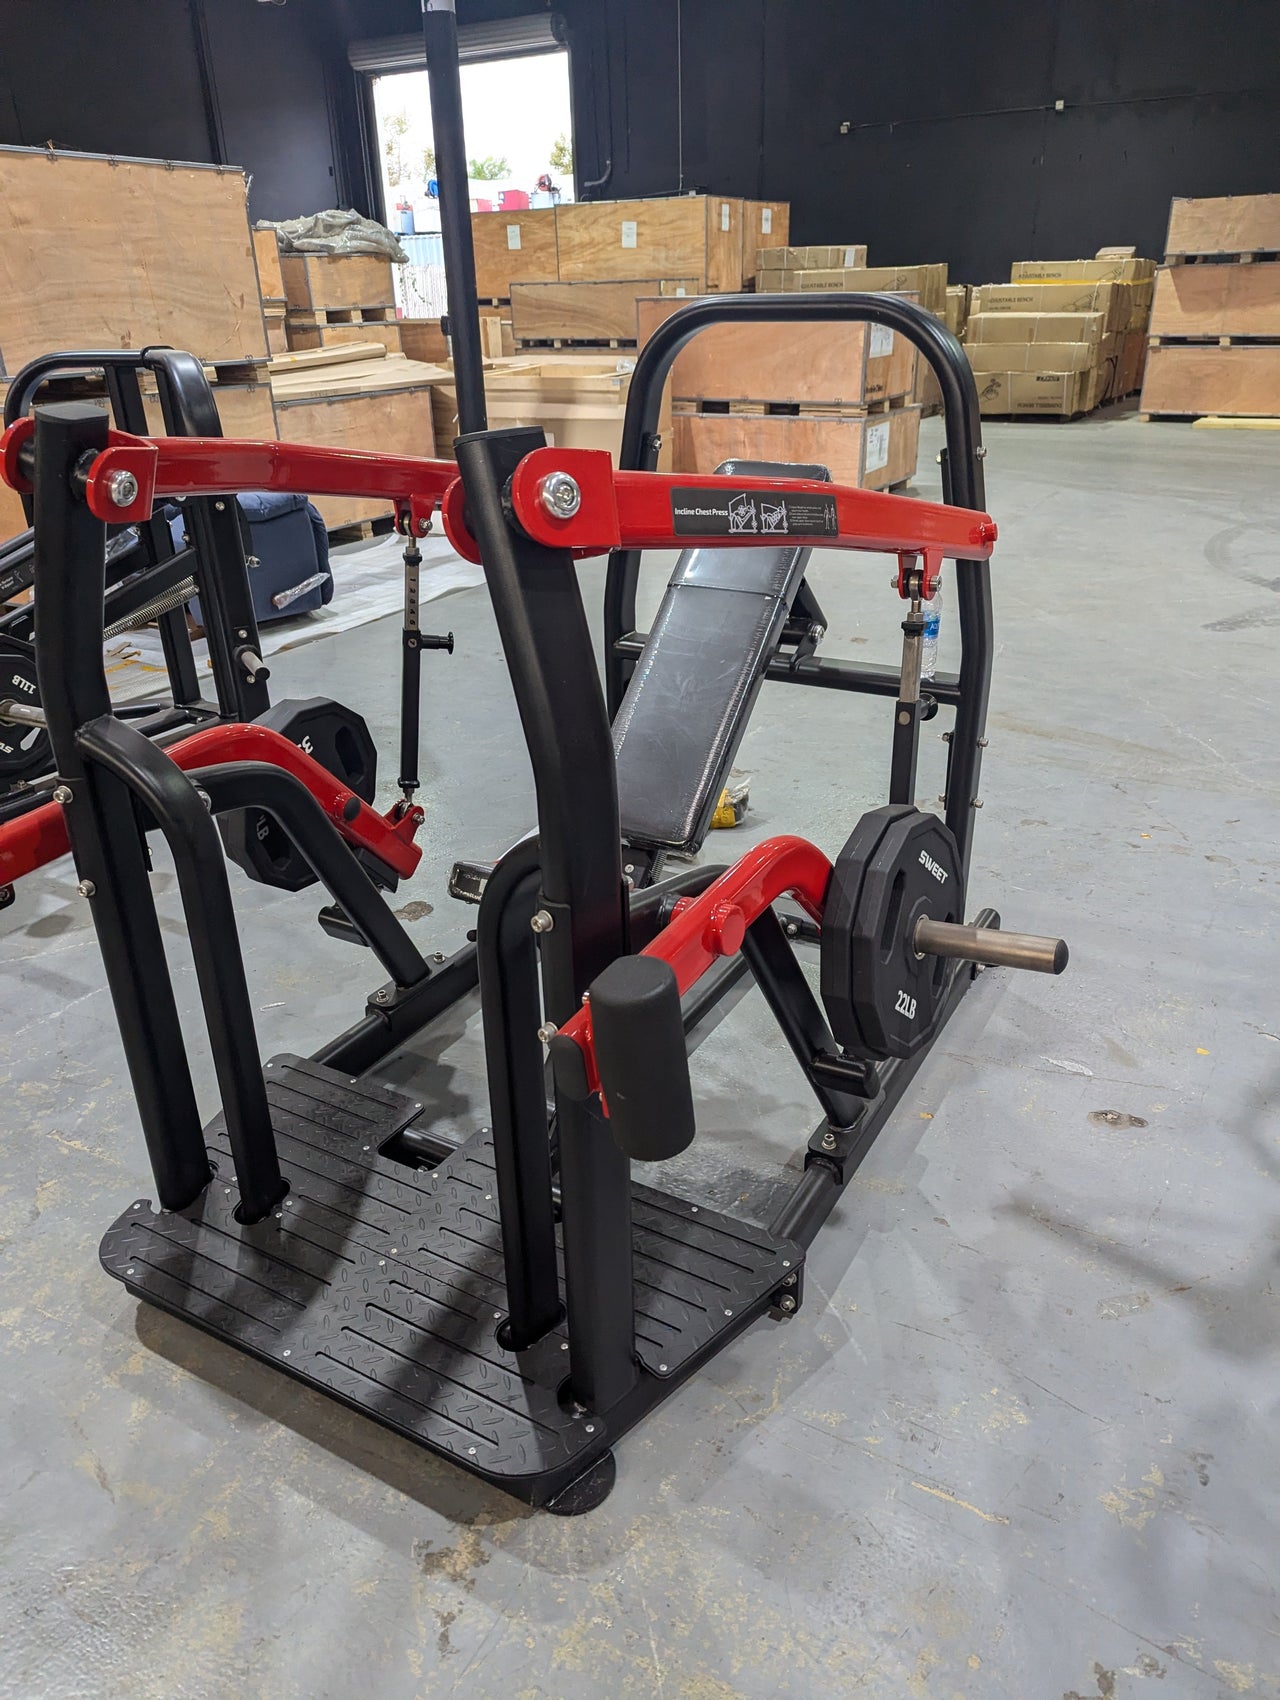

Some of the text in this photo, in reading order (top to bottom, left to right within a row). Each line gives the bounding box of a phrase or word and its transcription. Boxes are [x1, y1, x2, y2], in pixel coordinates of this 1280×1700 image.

[675, 508, 729, 516] Incline Chest Press
[11, 674, 37, 695] 11LB
[918, 850, 949, 885] SWEET
[895, 990, 917, 1020] 22LB
